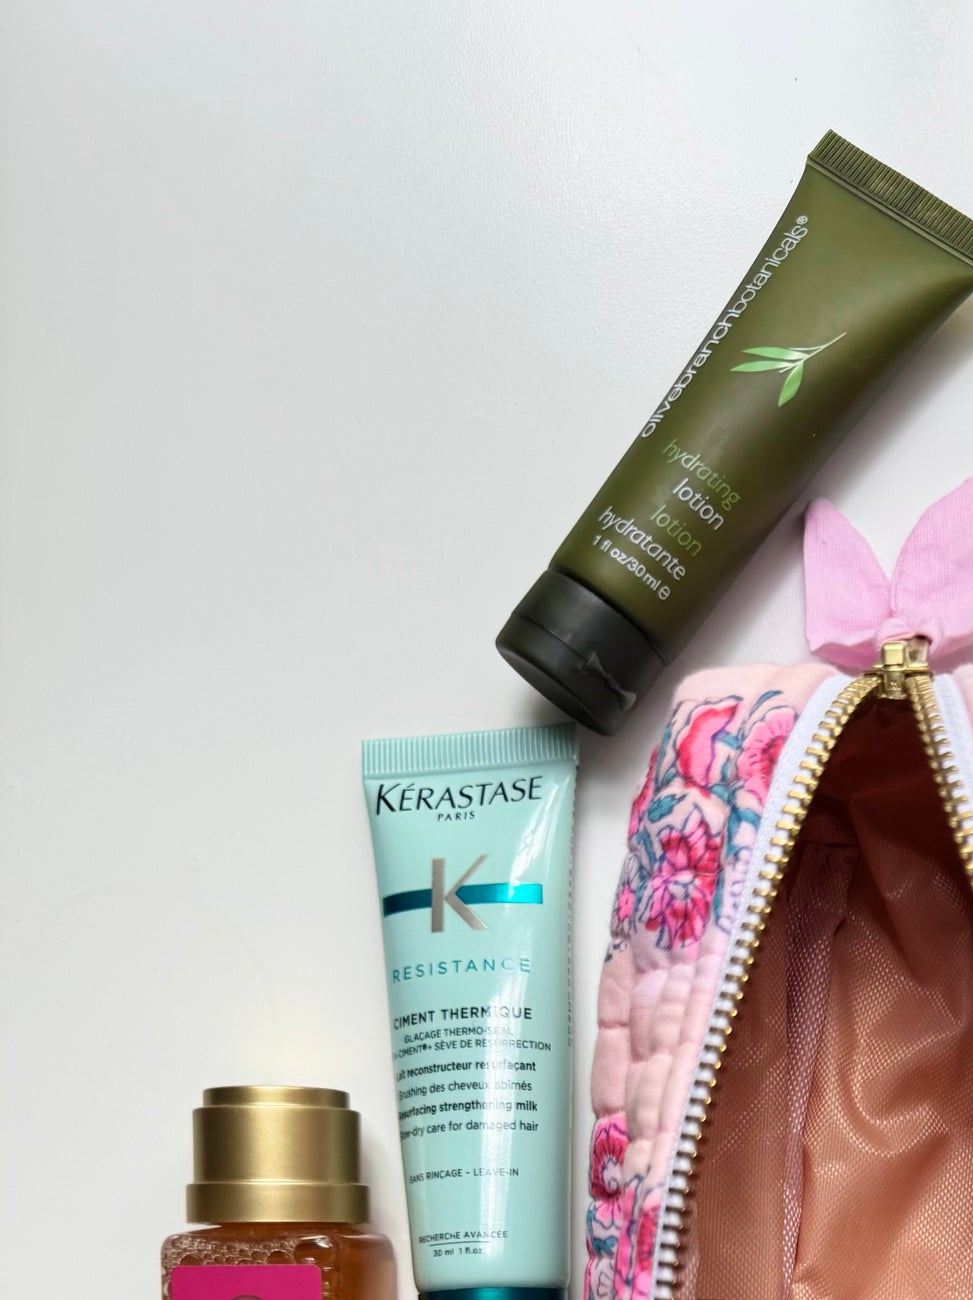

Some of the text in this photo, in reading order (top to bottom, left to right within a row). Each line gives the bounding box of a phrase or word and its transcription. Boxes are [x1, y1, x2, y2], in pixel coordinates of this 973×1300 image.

[663, 438, 741, 511] hydrating
[672, 478, 725, 530] lotion
[650, 504, 702, 557] lotion
[593, 535, 601, 546] 1
[601, 541, 610, 552] fl
[598, 506, 686, 580] hydratante
[376, 776, 543, 815] KÉRASTASE
[438, 811, 475, 822] PARIS
[431, 854, 489, 933] K
[392, 958, 532, 984] RESISTANCE
[394, 1007, 533, 1030] CIMENT THERMIQUE
[404, 1030, 441, 1044] GLAÇAGE
[460, 1039, 472, 1048] DE
[407, 1060, 473, 1078] reconstructeur
[475, 1061, 537, 1072] resurfaçant
[429, 1083, 446, 1093] des
[448, 1081, 488, 1091] cheveux
[439, 1100, 513, 1113] strengthening
[516, 1100, 538, 1112] milk
[426, 1120, 539, 1134] care for damaged hair
[426, 1168, 463, 1180] RINÇAGE
[473, 1168, 519, 1177] LEAVE-IN
[418, 1231, 460, 1244] RECHERCHE
[433, 1249, 443, 1258] 30
[444, 1248, 455, 1256] ml
